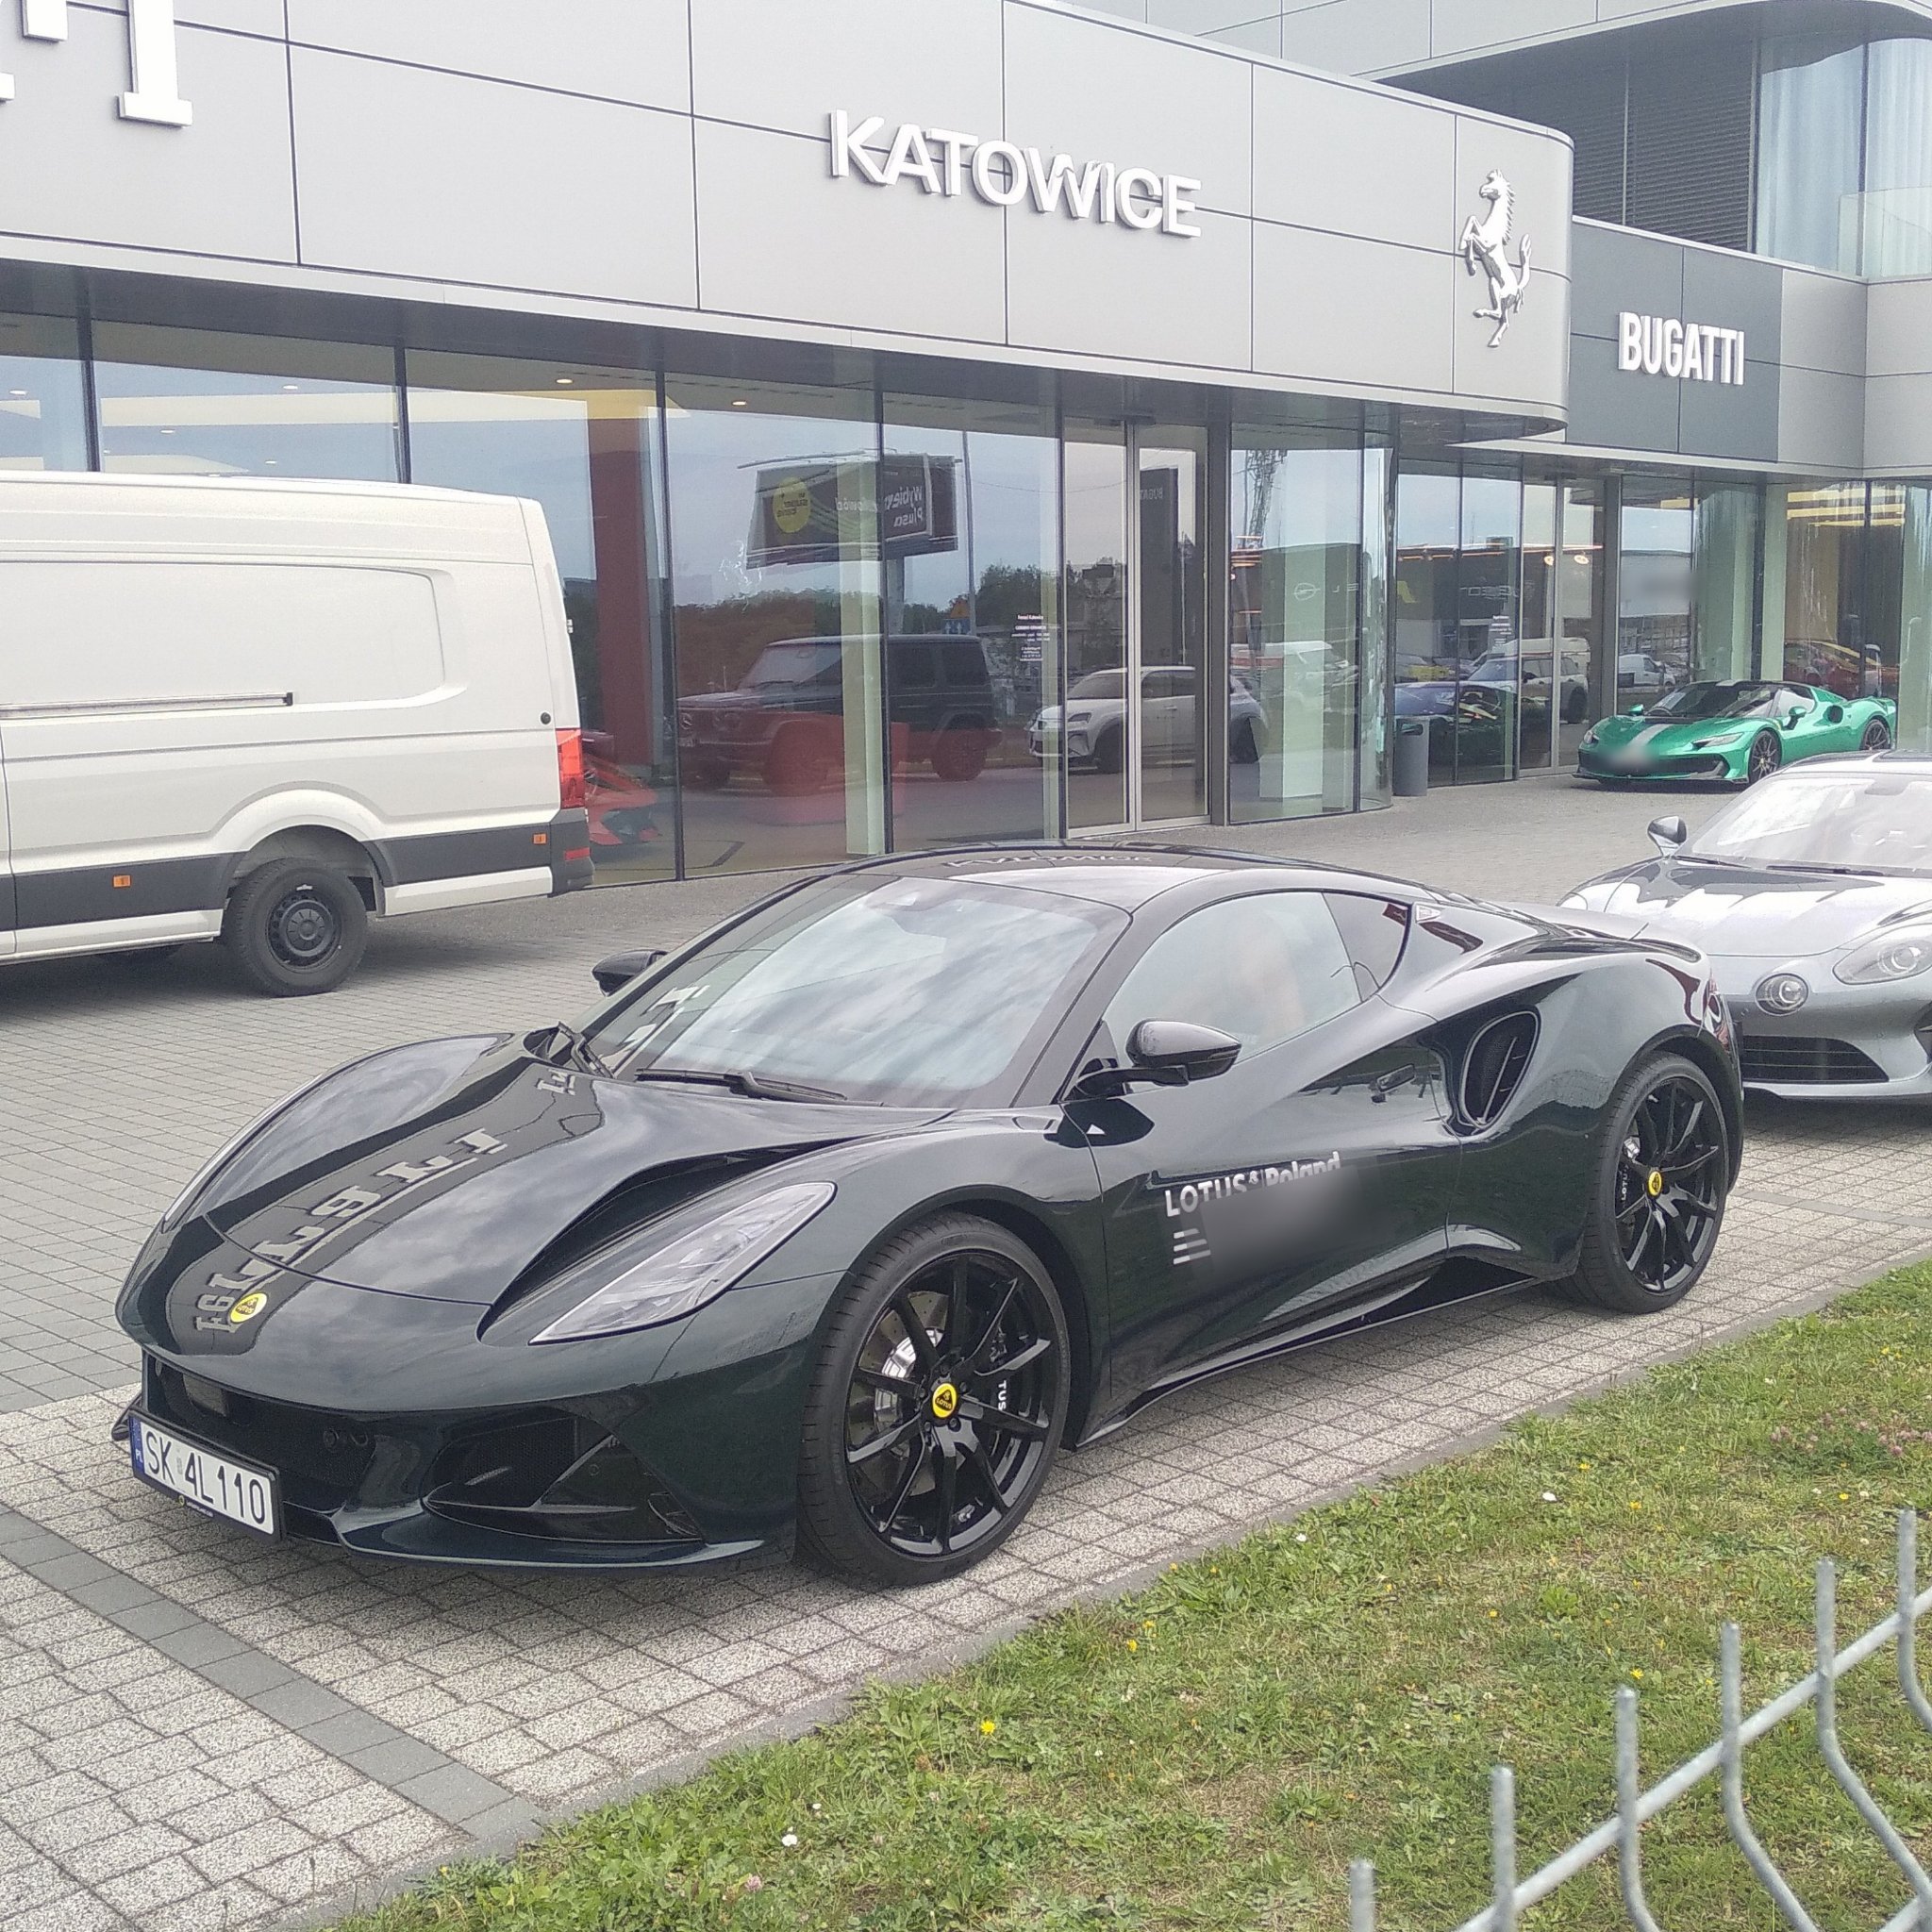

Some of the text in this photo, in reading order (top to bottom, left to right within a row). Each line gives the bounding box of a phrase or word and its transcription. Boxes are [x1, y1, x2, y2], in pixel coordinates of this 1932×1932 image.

[829, 109, 1202, 239] KATOWICE
[1617, 311, 1745, 386] BUGATTI
[936, 1397, 952, 1409] LOTUS
[998, 1379, 1007, 1411] TUS
[146, 1431, 175, 1486] SK
